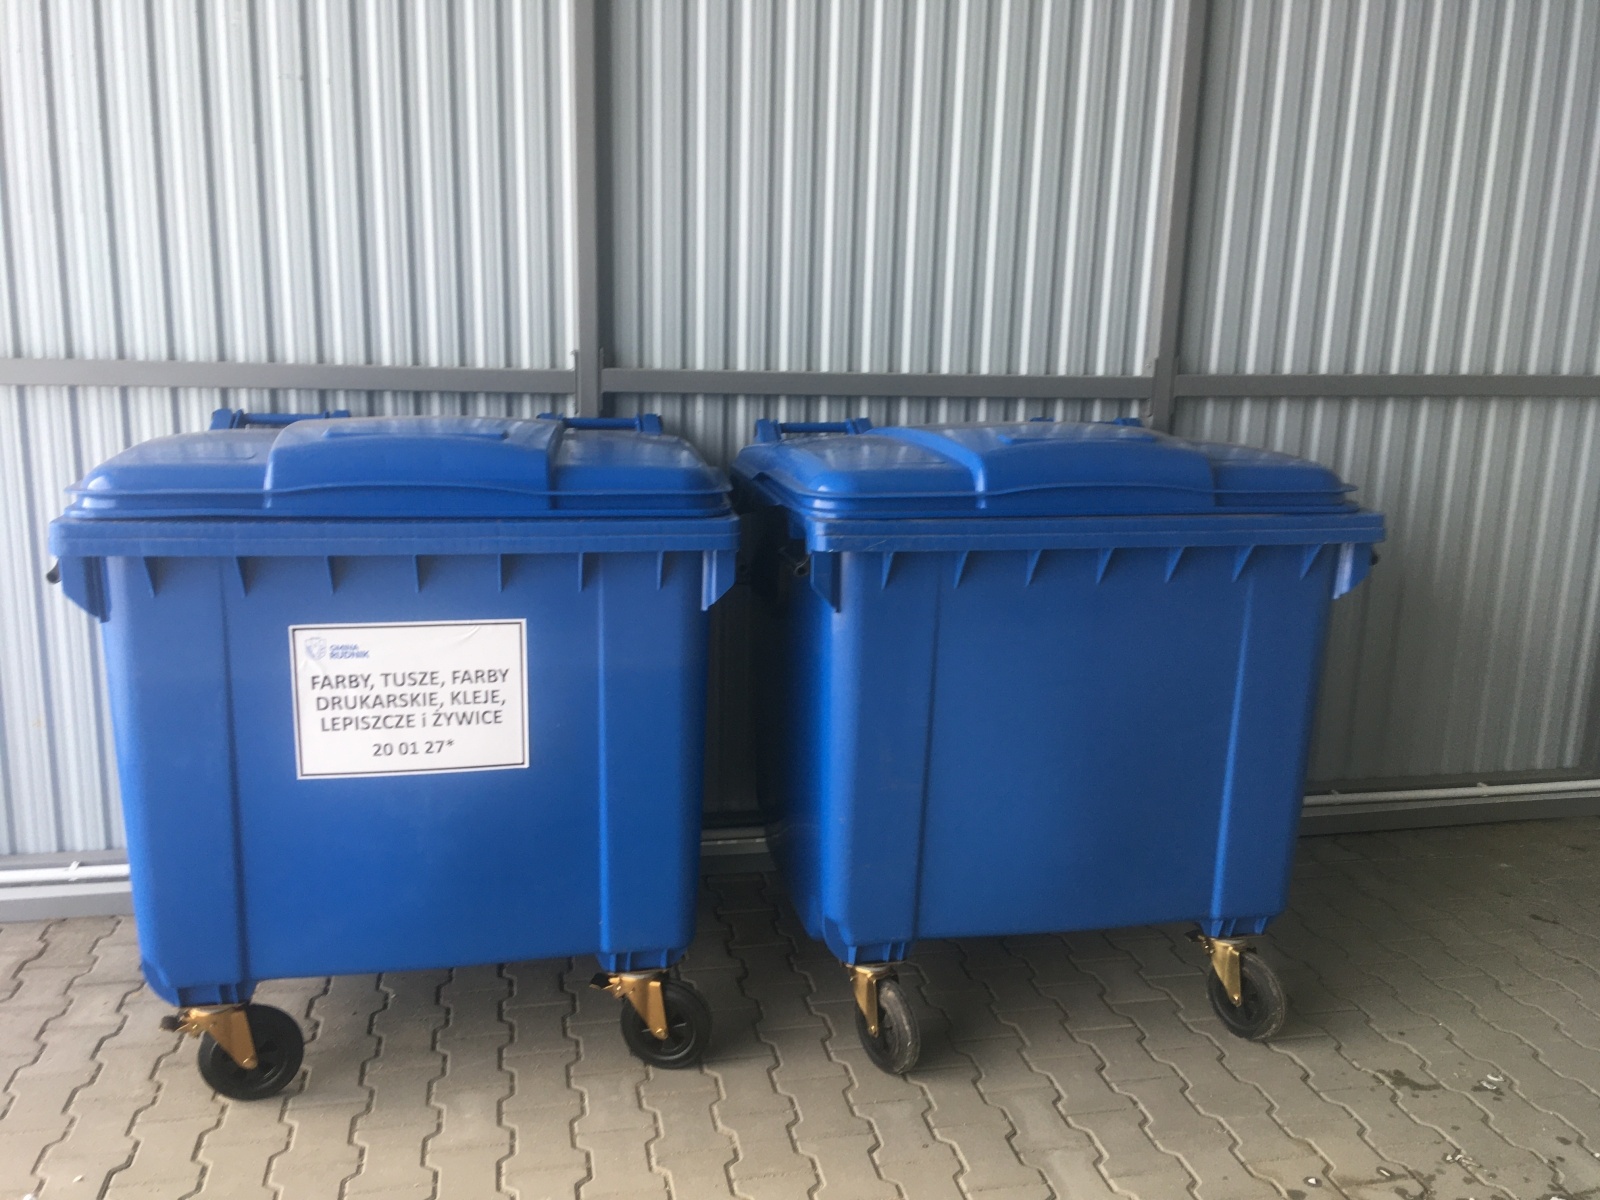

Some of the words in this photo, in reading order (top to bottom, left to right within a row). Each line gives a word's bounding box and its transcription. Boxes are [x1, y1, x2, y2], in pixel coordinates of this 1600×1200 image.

[311, 673, 375, 691] FARBY,
[380, 670, 446, 688] TUSZE,
[451, 668, 510, 684] FARBY
[316, 691, 444, 711] DRUKARSKIE,
[450, 689, 506, 706] KLEJE,
[320, 713, 416, 732] LEPISZCZE
[421, 713, 427, 728] i
[372, 743, 393, 757] 20
[398, 741, 419, 755] 01
